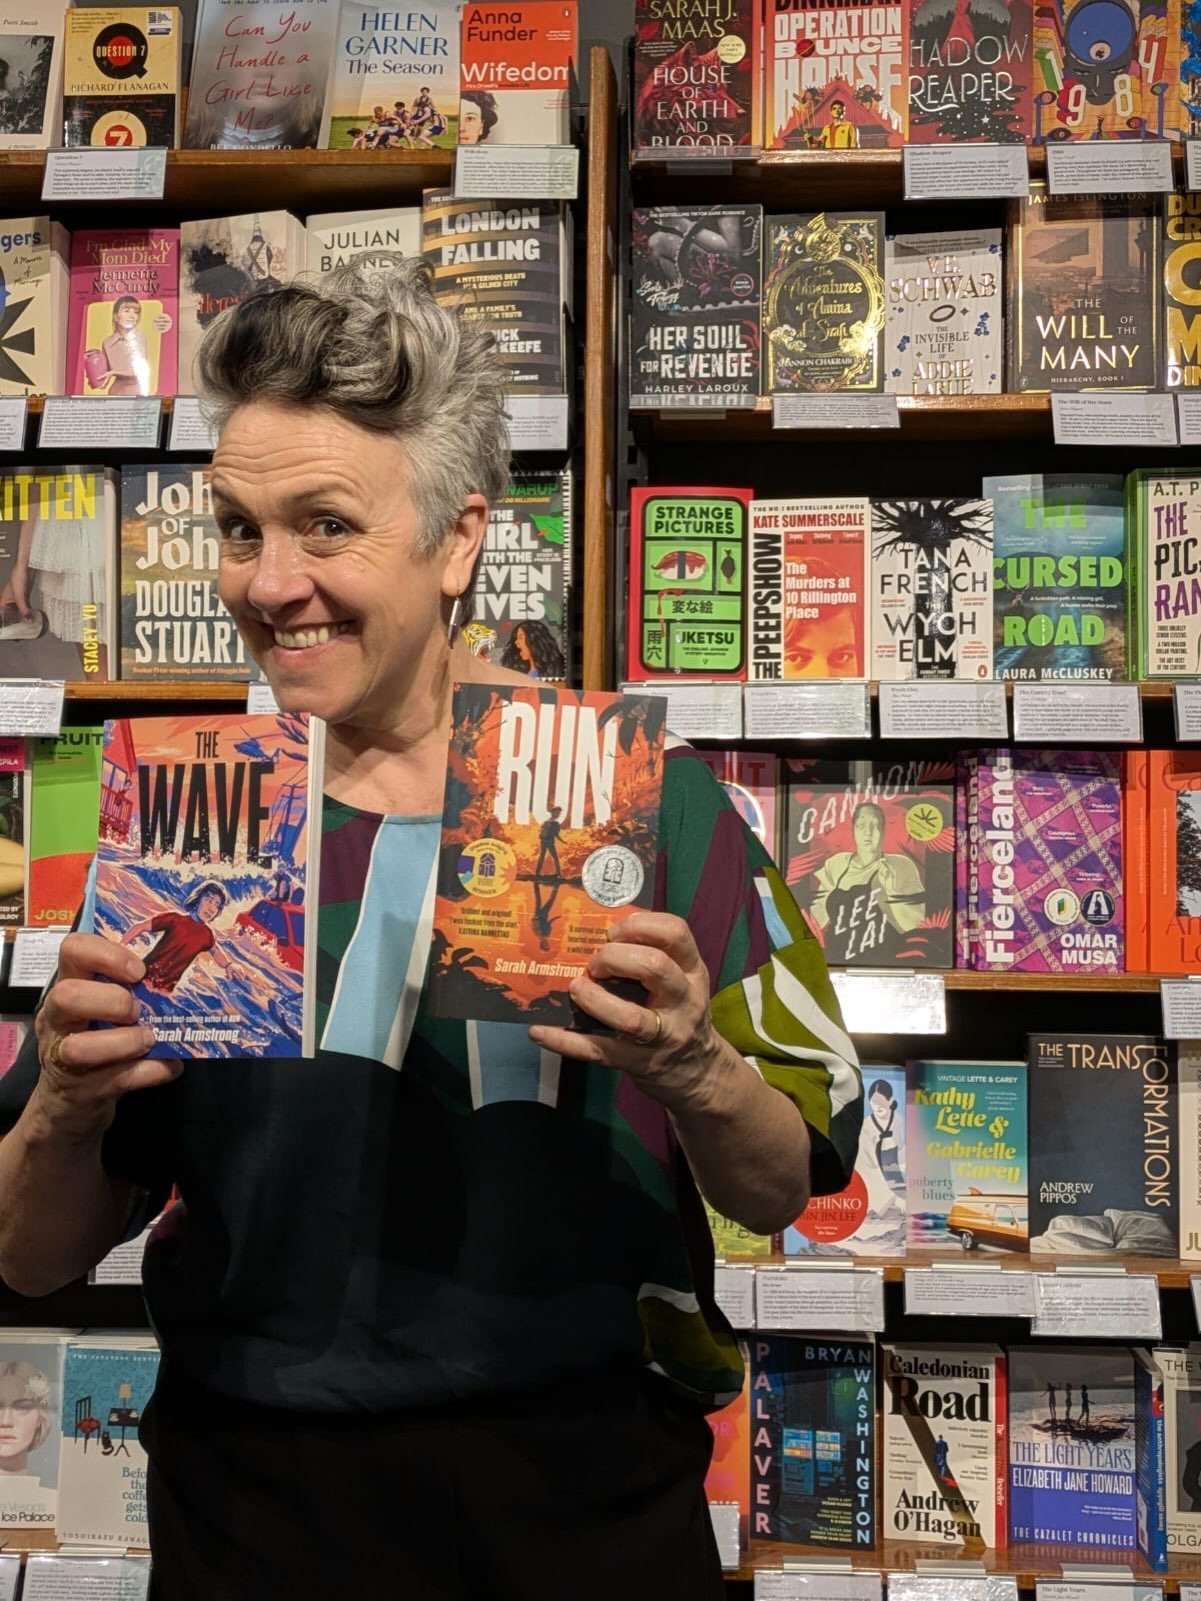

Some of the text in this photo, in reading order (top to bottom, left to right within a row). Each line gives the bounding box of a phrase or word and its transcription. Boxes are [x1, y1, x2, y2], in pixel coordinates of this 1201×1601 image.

[469, 10, 522, 25] Anna
[650, 0, 720, 18] SARAH
[225, 11, 312, 44] Can You
[361, 13, 437, 31] HELEN
[662, 19, 725, 39] MAAS
[774, 7, 902, 41] OPERATION
[467, 26, 538, 41] Funder
[96, 46, 146, 57] QUESTION 7
[345, 36, 448, 56] GARNER
[216, 46, 309, 70] Handle a
[347, 59, 443, 75] The Season
[461, 62, 570, 82] Wifedom
[654, 66, 732, 85] HOUSE
[71, 82, 169, 91] RICHARD FLANAGAN
[205, 75, 254, 104] Girl
[682, 87, 702, 99] OF
[908, 71, 1016, 112] REAPER
[657, 100, 727, 120] EARTH
[676, 121, 708, 133] AND
[442, 208, 540, 236] LONDON
[150, 239, 173, 254] My
[324, 229, 400, 250] JULIAN
[92, 252, 166, 265] Mom Died
[442, 239, 540, 266] FALLING
[95, 269, 159, 281] Jennette
[92, 281, 160, 294] McCurdy
[784, 279, 863, 299] Adventures
[890, 273, 998, 303] SCHWAB
[1076, 299, 1101, 308] THE
[1036, 315, 1113, 340] WILL
[1120, 316, 1135, 324] OF
[649, 325, 747, 350] HER SOUL
[915, 331, 969, 344] INVISIBLE
[1117, 326, 1137, 335] THE
[500, 340, 542, 353] KEEFE
[930, 343, 954, 353] LIFE
[641, 353, 753, 378] FOR REVENGE
[1040, 345, 1140, 370] MANY
[913, 359, 974, 379] ADDIE
[645, 384, 749, 393] HARLEY LAROUX
[490, 510, 514, 521] THE
[656, 506, 733, 520] STRANGE
[754, 513, 864, 528] KATE SUMMERSCALE
[1154, 501, 1188, 540] THE
[161, 518, 190, 535] OF
[655, 521, 735, 534] PICTURES
[483, 552, 513, 563] ITH
[514, 552, 533, 563] THE
[899, 547, 971, 569] TANA
[785, 562, 807, 575] The
[993, 555, 1123, 589] CURSED
[786, 576, 851, 590] Murders at
[880, 571, 988, 595] FRENCH
[753, 532, 782, 661] PEEPSHOW
[786, 590, 857, 605] 10 Rillington
[82, 604, 97, 625] YU
[672, 600, 714, 614] 変な絵
[786, 606, 819, 619] Place
[883, 611, 977, 636] WYCH
[1003, 614, 1105, 647] ROAD
[135, 621, 246, 664] STUART
[677, 632, 735, 645] UKETSU
[84, 627, 99, 673] STACEY
[899, 638, 956, 663] ELM
[753, 662, 782, 679] THE
[995, 667, 1113, 680] LAURA McCLUSKEY
[195, 731, 220, 759] THE
[494, 698, 619, 830] RUN
[138, 762, 275, 869] WAVE
[986, 749, 1015, 962] Fierceland
[834, 888, 882, 936] LEE
[845, 913, 888, 960] LAI
[1060, 933, 1118, 949] OMAR
[1061, 949, 1118, 965] MUSA
[495, 958, 584, 977] Sarah Armstrong
[152, 1027, 239, 1044] Sarah Armstrong
[1038, 1043, 1064, 1057] THE
[914, 1087, 975, 1110] Kathy
[926, 1141, 1017, 1160] Gabrielle
[956, 1161, 1020, 1184] Carey
[922, 1189, 956, 1200] blues
[1039, 1181, 1094, 1194] ANDREW
[1039, 1193, 1077, 1204] PIPPOS
[805, 1346, 871, 1364] BRYAN
[889, 1355, 990, 1379] Caledonian
[1164, 1360, 1193, 1372] THE
[888, 1375, 991, 1422] Road
[754, 1342, 771, 1534] PALAVER
[854, 1368, 872, 1545] WASHINGTON
[1013, 1442, 1040, 1462] THE
[1045, 1443, 1084, 1466] LIGHT
[1085, 1445, 1131, 1469] YEARS
[1013, 1468, 1132, 1495] ELIZABETH JANE HOWARD
[896, 1488, 979, 1514] Andrew
[1, 1512, 55, 1522] Ice Palace
[894, 1510, 981, 1540] O'Hagan
[62, 1533, 114, 1541] YOSHIKAZU
[1034, 1529, 1072, 1541] CAZALET
[1077, 1531, 1134, 1546] CHRONICLES
